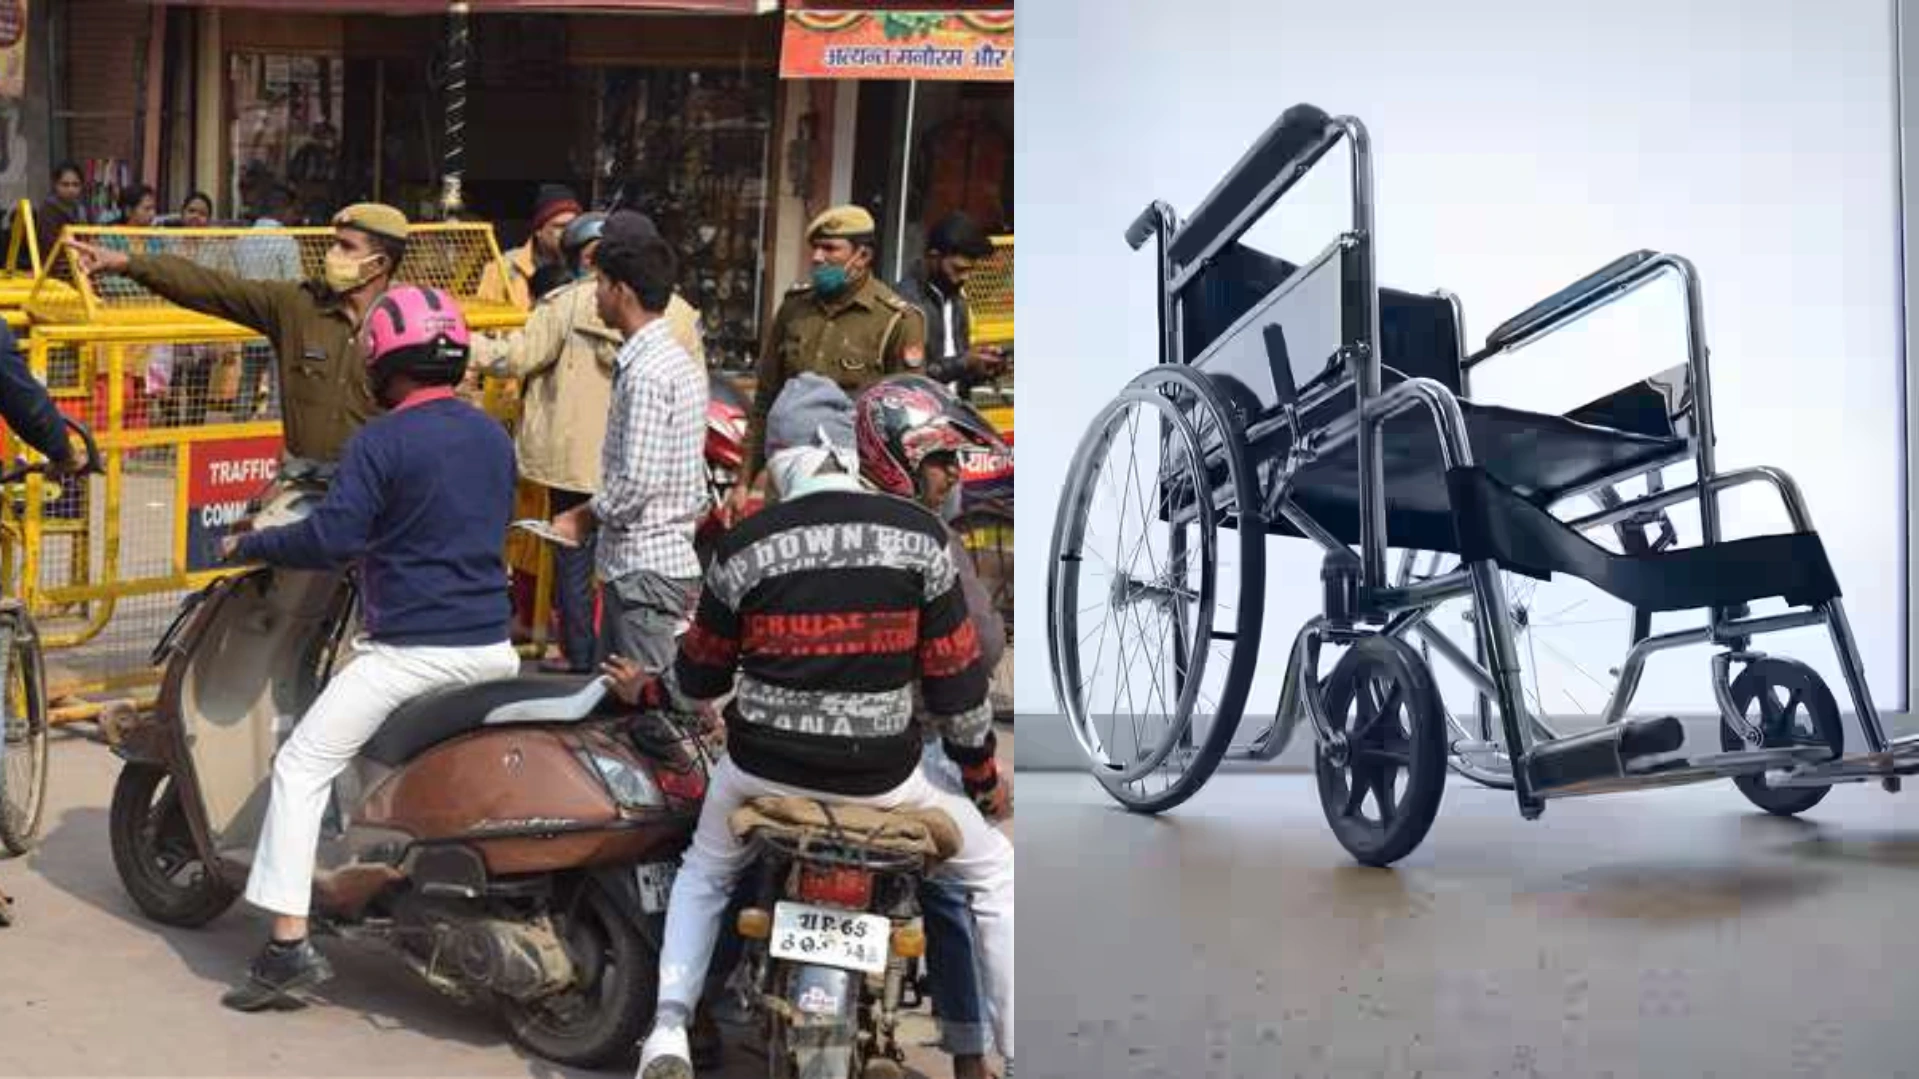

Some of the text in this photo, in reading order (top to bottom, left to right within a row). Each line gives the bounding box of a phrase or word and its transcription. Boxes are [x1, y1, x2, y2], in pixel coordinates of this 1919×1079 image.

[894, 43, 964, 68] मनोरम
[973, 42, 1007, 68] और
[208, 458, 277, 486] TRAFFIC
[755, 523, 863, 569] DOWN
